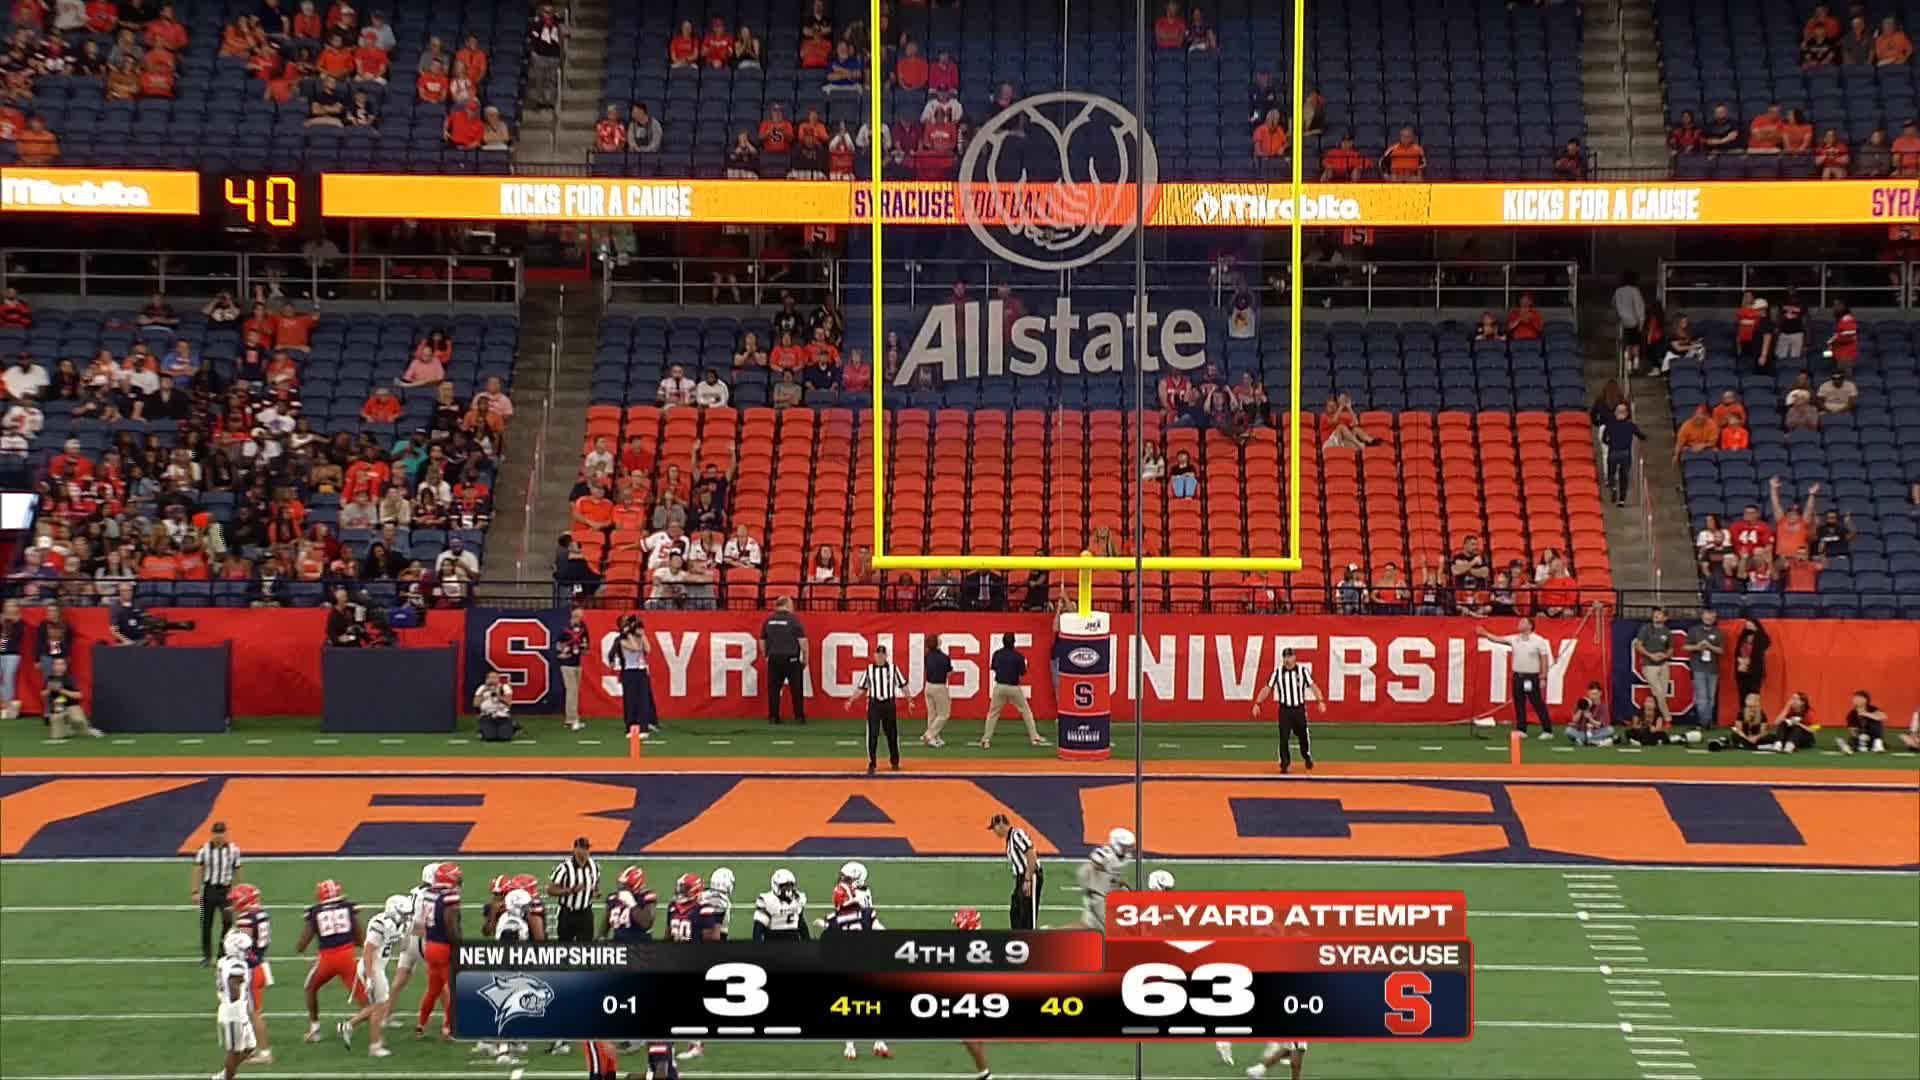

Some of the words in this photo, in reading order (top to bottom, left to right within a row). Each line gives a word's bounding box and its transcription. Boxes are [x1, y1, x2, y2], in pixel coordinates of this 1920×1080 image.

[225, 177, 295, 226] 40
[500, 183, 561, 214] KICKS
[564, 184, 605, 216] FOR
[608, 185, 624, 216] A
[626, 185, 693, 217] CAUSE
[854, 190, 955, 218] SYRACUSE
[961, 191, 1053, 219] OOTBALL
[1503, 189, 1564, 220] KICKS
[1568, 188, 1609, 220] FOR
[1612, 188, 1628, 220] A
[1631, 187, 1700, 220] CAUSE
[892, 295, 1207, 387] Allstate
[1739, 530, 1758, 544] 44
[485, 618, 550, 704] S
[601, 631, 1033, 699] SYRCUSE
[1109, 634, 1577, 705] NIVERSITY
[1074, 682, 1095, 709] S
